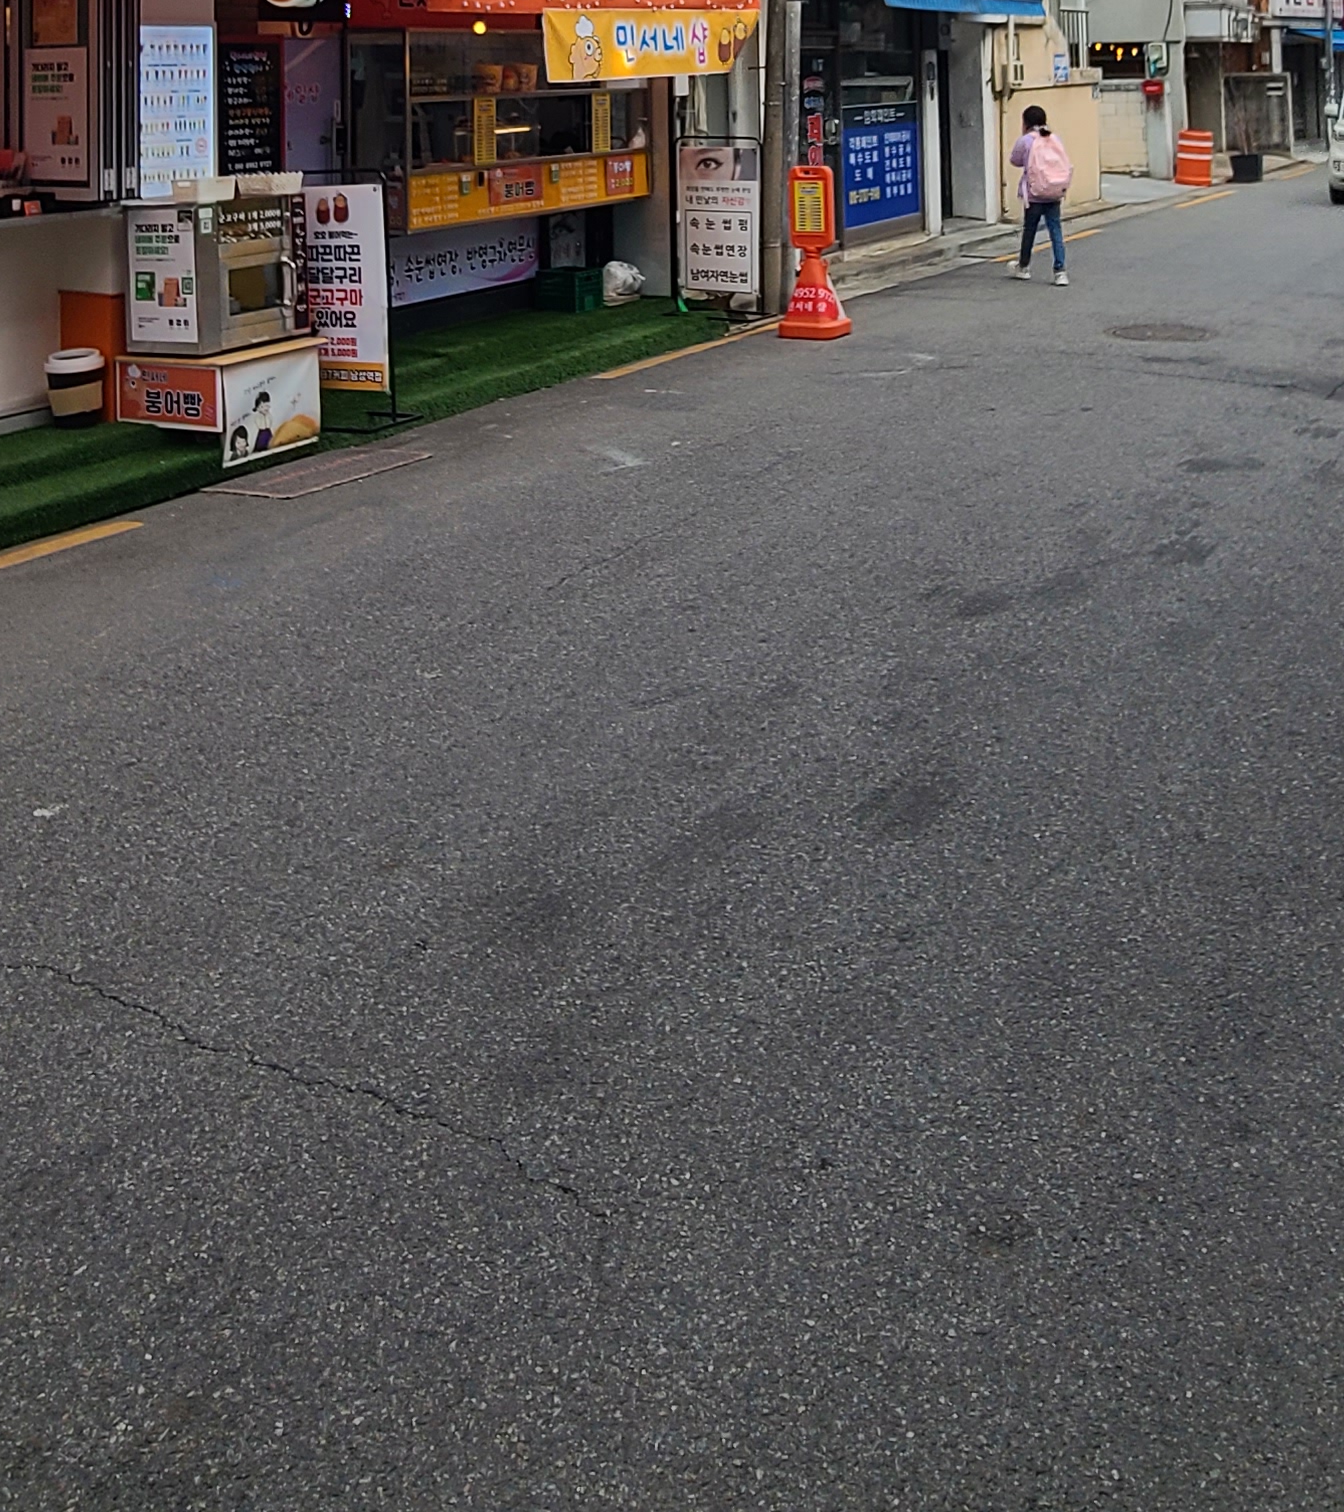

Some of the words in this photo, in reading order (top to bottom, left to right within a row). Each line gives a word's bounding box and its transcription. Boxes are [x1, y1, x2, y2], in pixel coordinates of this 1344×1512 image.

[615, 22, 685, 64] 민서네
[689, 20, 709, 65] 샵
[690, 242, 748, 258] 속눈썹연장
[307, 266, 362, 285] 달달구리
[308, 289, 363, 307] 군고구마
[315, 310, 358, 328] 있어요
[144, 388, 203, 419] 붕어빵
